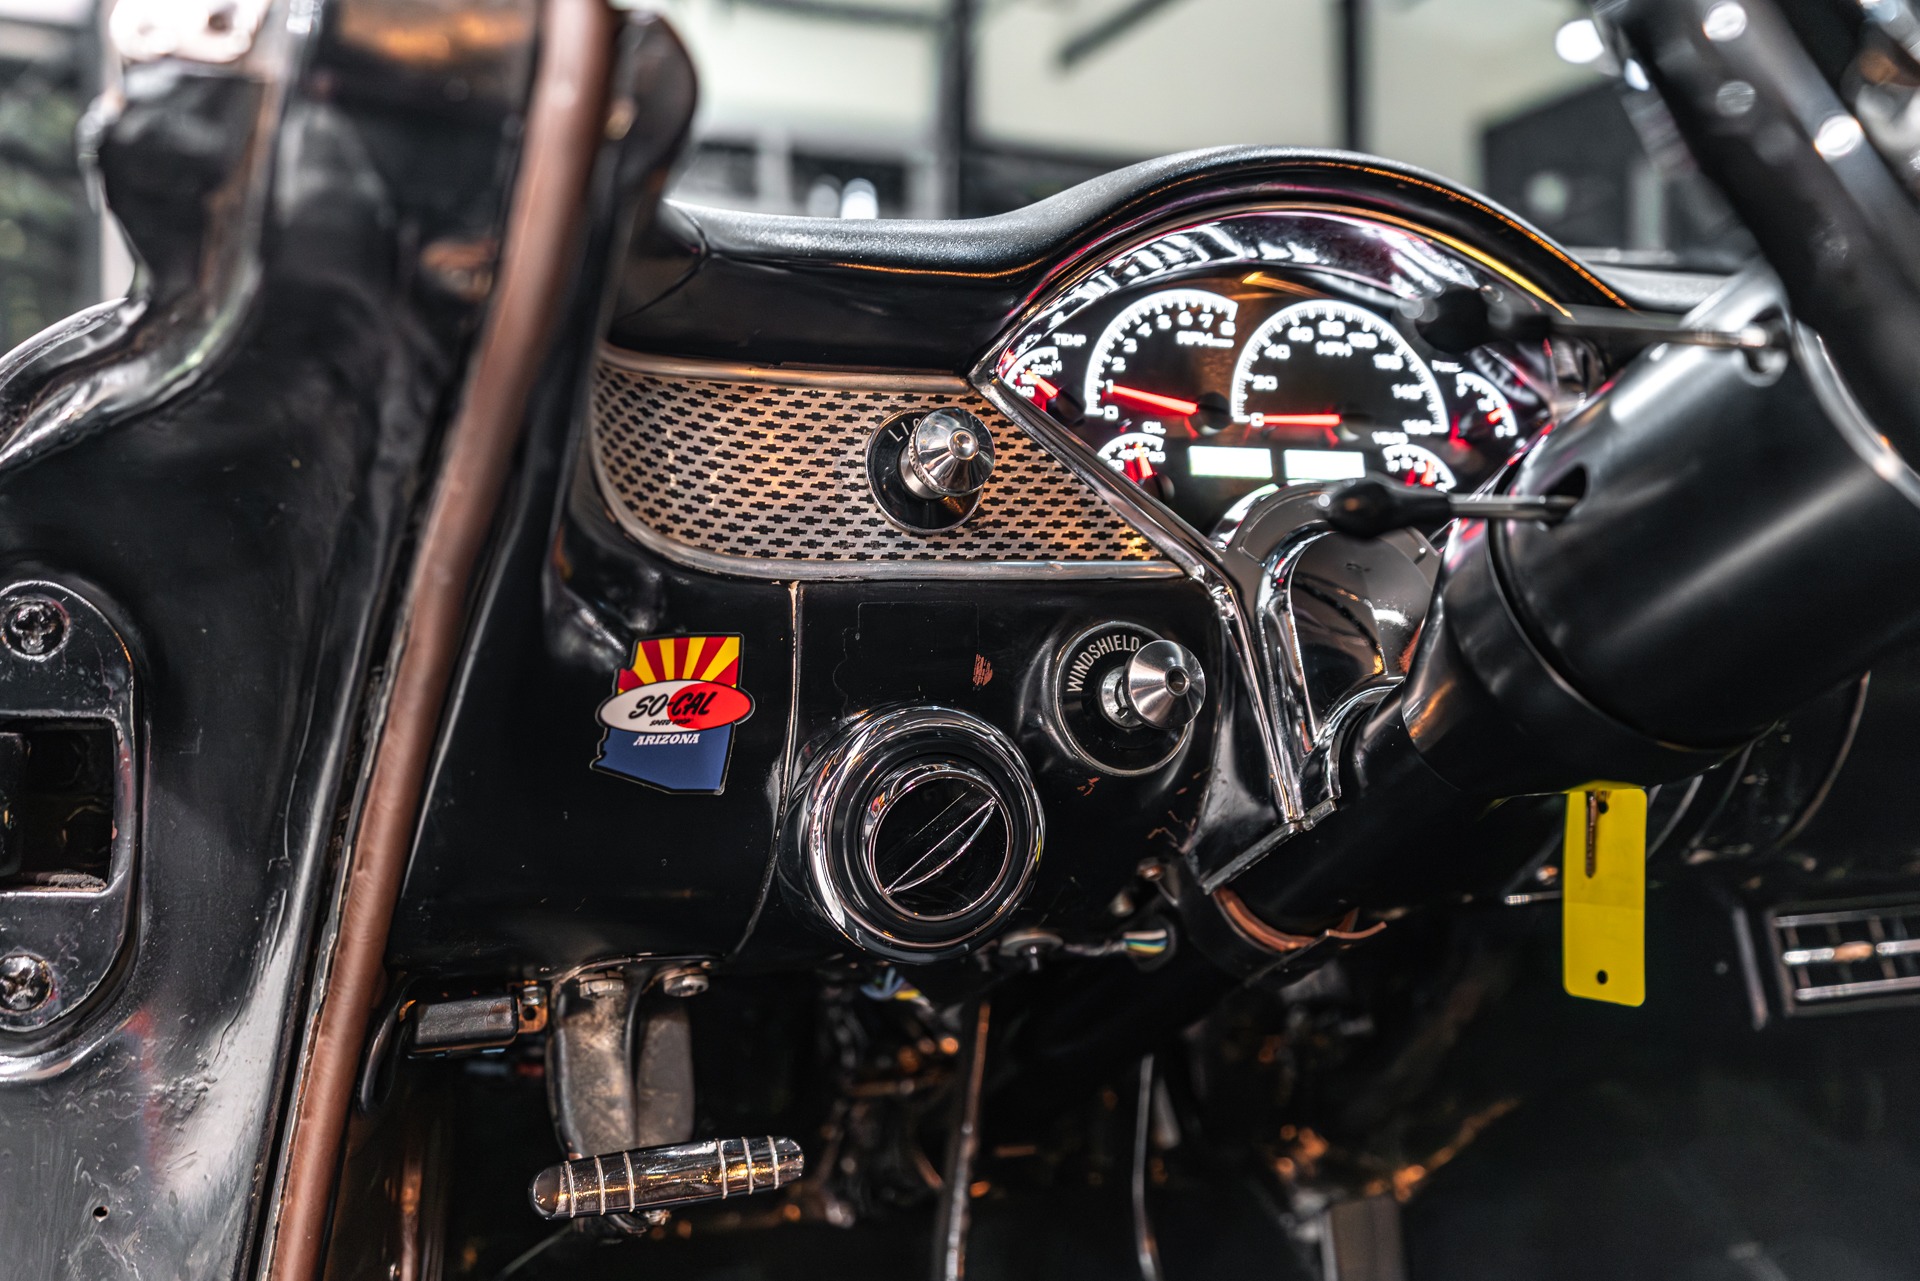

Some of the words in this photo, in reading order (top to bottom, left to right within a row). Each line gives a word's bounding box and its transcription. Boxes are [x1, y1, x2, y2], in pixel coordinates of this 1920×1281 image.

[1157, 314, 1172, 330] 5
[1199, 313, 1214, 328] 7
[1136, 322, 1152, 337] 4
[1288, 326, 1314, 342] 60
[1052, 333, 1087, 348] TEMP
[1123, 338, 1138, 352] 3
[1264, 344, 1291, 360] 40
[1112, 357, 1126, 372] 2
[1105, 379, 1115, 393] 1
[1252, 374, 1278, 391] 20
[1104, 405, 1119, 420] 0
[1142, 421, 1166, 434] OIL
[1066, 634, 1140, 693] WINDSHIELD
[629, 692, 718, 719] SO-CAL
[633, 733, 701, 746] ARIZONA
